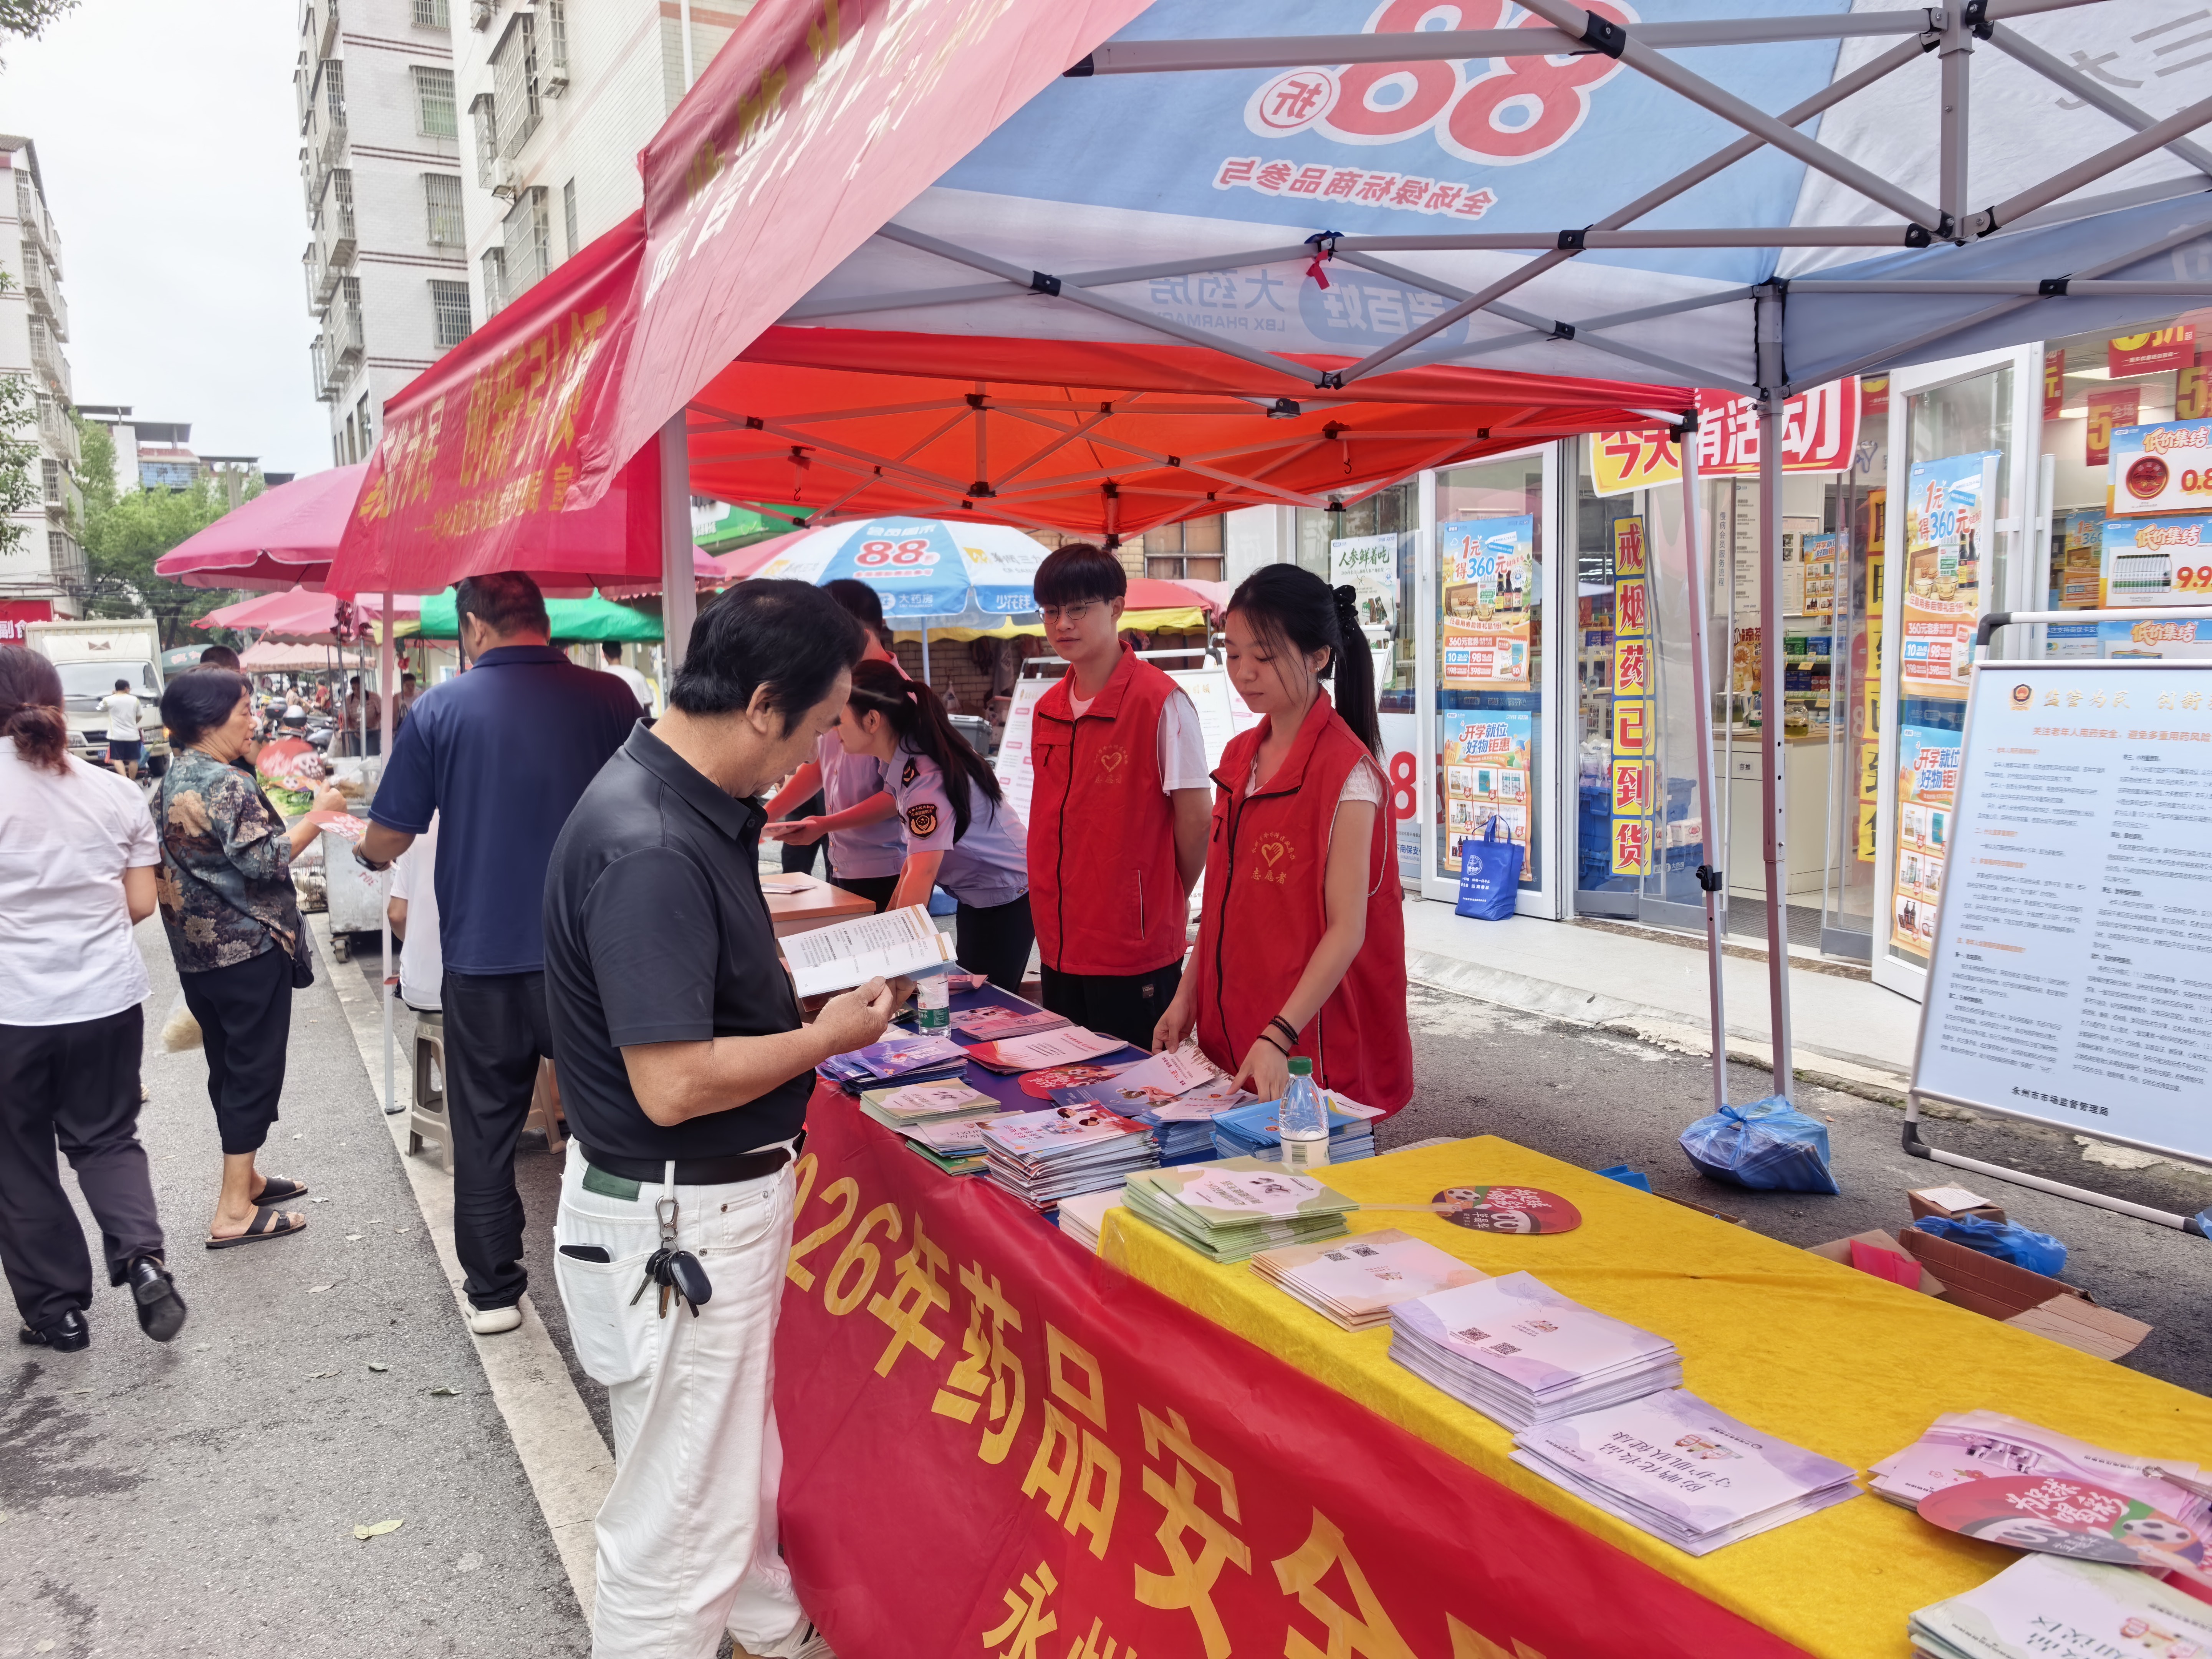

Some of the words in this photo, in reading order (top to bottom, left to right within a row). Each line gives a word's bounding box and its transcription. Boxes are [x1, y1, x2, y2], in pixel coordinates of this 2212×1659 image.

[2143, 427, 2209, 454] 低价集结
[1925, 480, 1944, 513] 1元
[1919, 508, 1970, 541] 得360元
[1462, 535, 1482, 559] 1元
[2134, 524, 2201, 551] 低价集结
[857, 539, 927, 565] 88
[1339, 546, 1390, 568] 人参鲜着吃
[1455, 555, 1507, 579] 得360元
[899, 594, 933, 604] 大药房
[996, 594, 1031, 609] 少花钱
[2131, 620, 2196, 646] 低价集结
[1614, 523, 1651, 870] 戒烟药已到货
[2043, 689, 2131, 709] 监管为民
[2157, 689, 2212, 711] 创新
[1459, 723, 1508, 742] 开学就位
[1466, 738, 1511, 755] 好物钜惠
[1251, 867, 1287, 884] 志愿者
[2011, 1086, 2109, 1117] 永州市市场监督管理局
